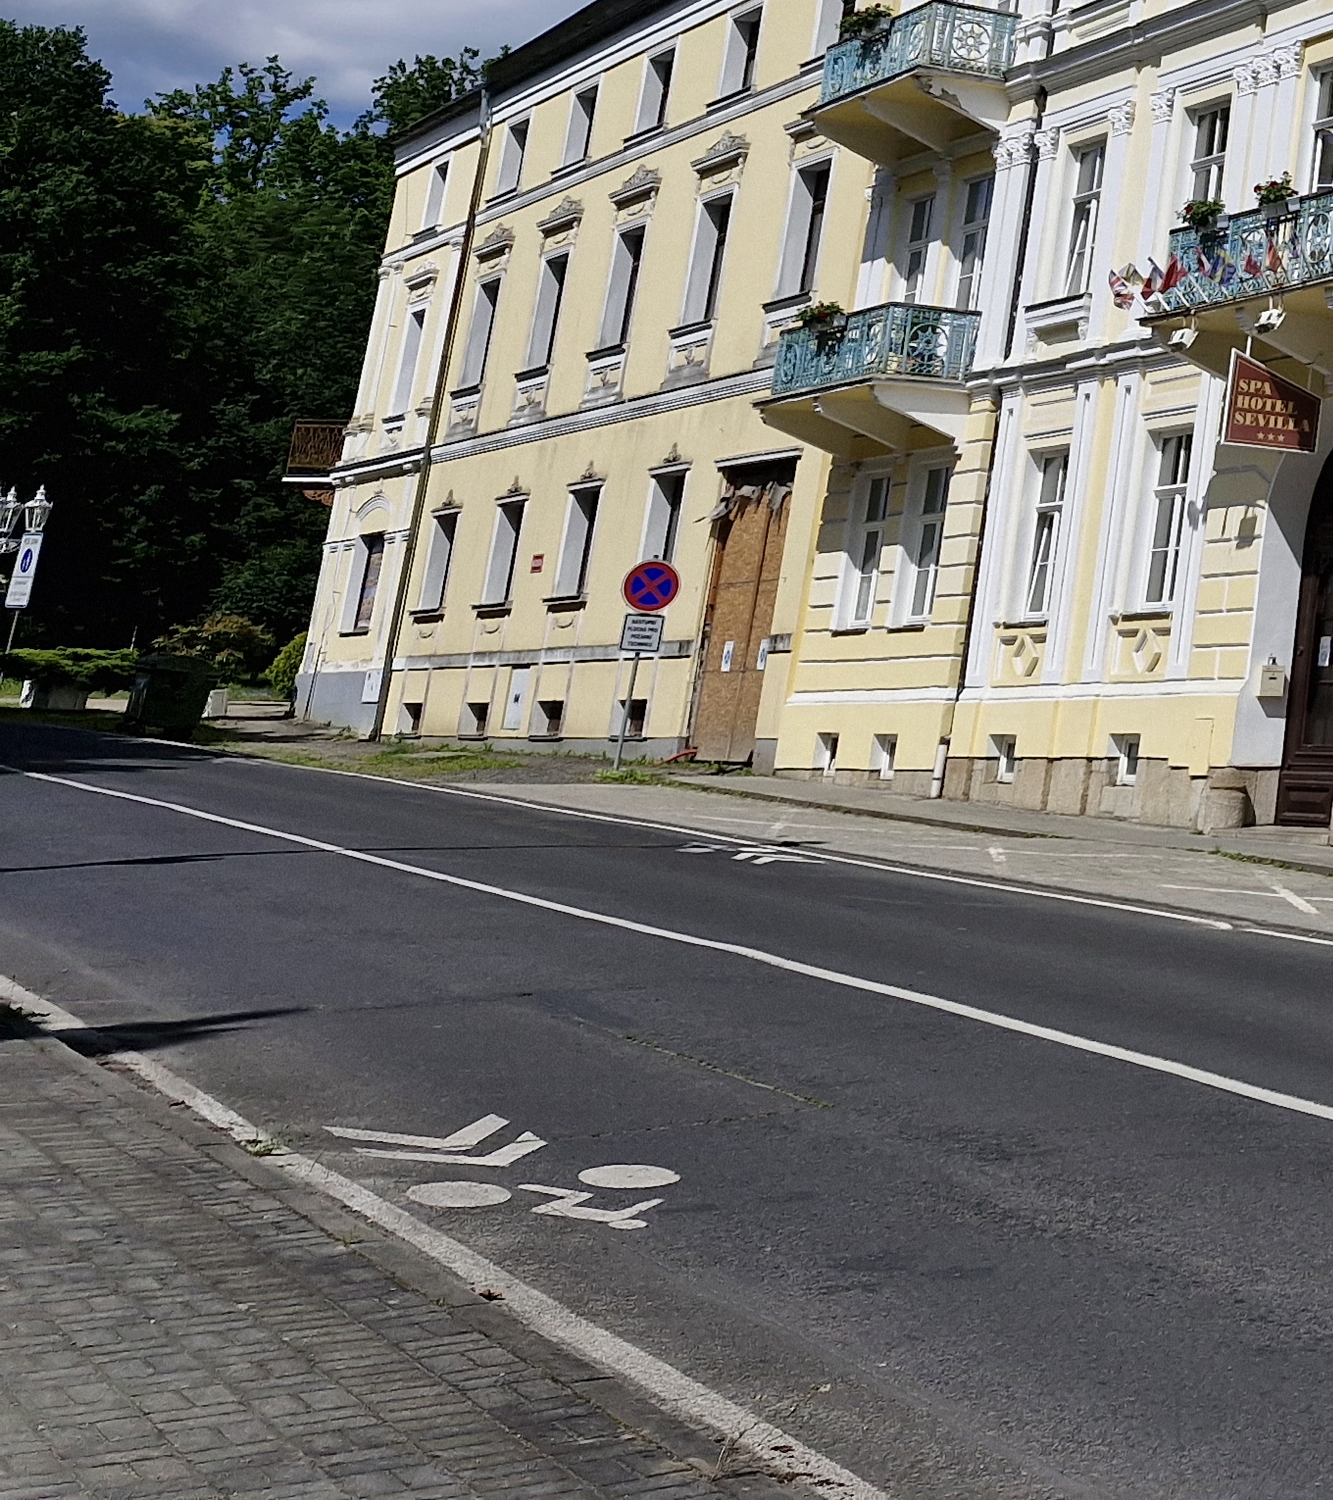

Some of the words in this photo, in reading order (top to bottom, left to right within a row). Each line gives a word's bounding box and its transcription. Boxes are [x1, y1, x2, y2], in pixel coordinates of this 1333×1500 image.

[1237, 378, 1272, 396] SPA
[1236, 394, 1298, 415] HOTEL
[1234, 411, 1310, 432] SEVILLA
